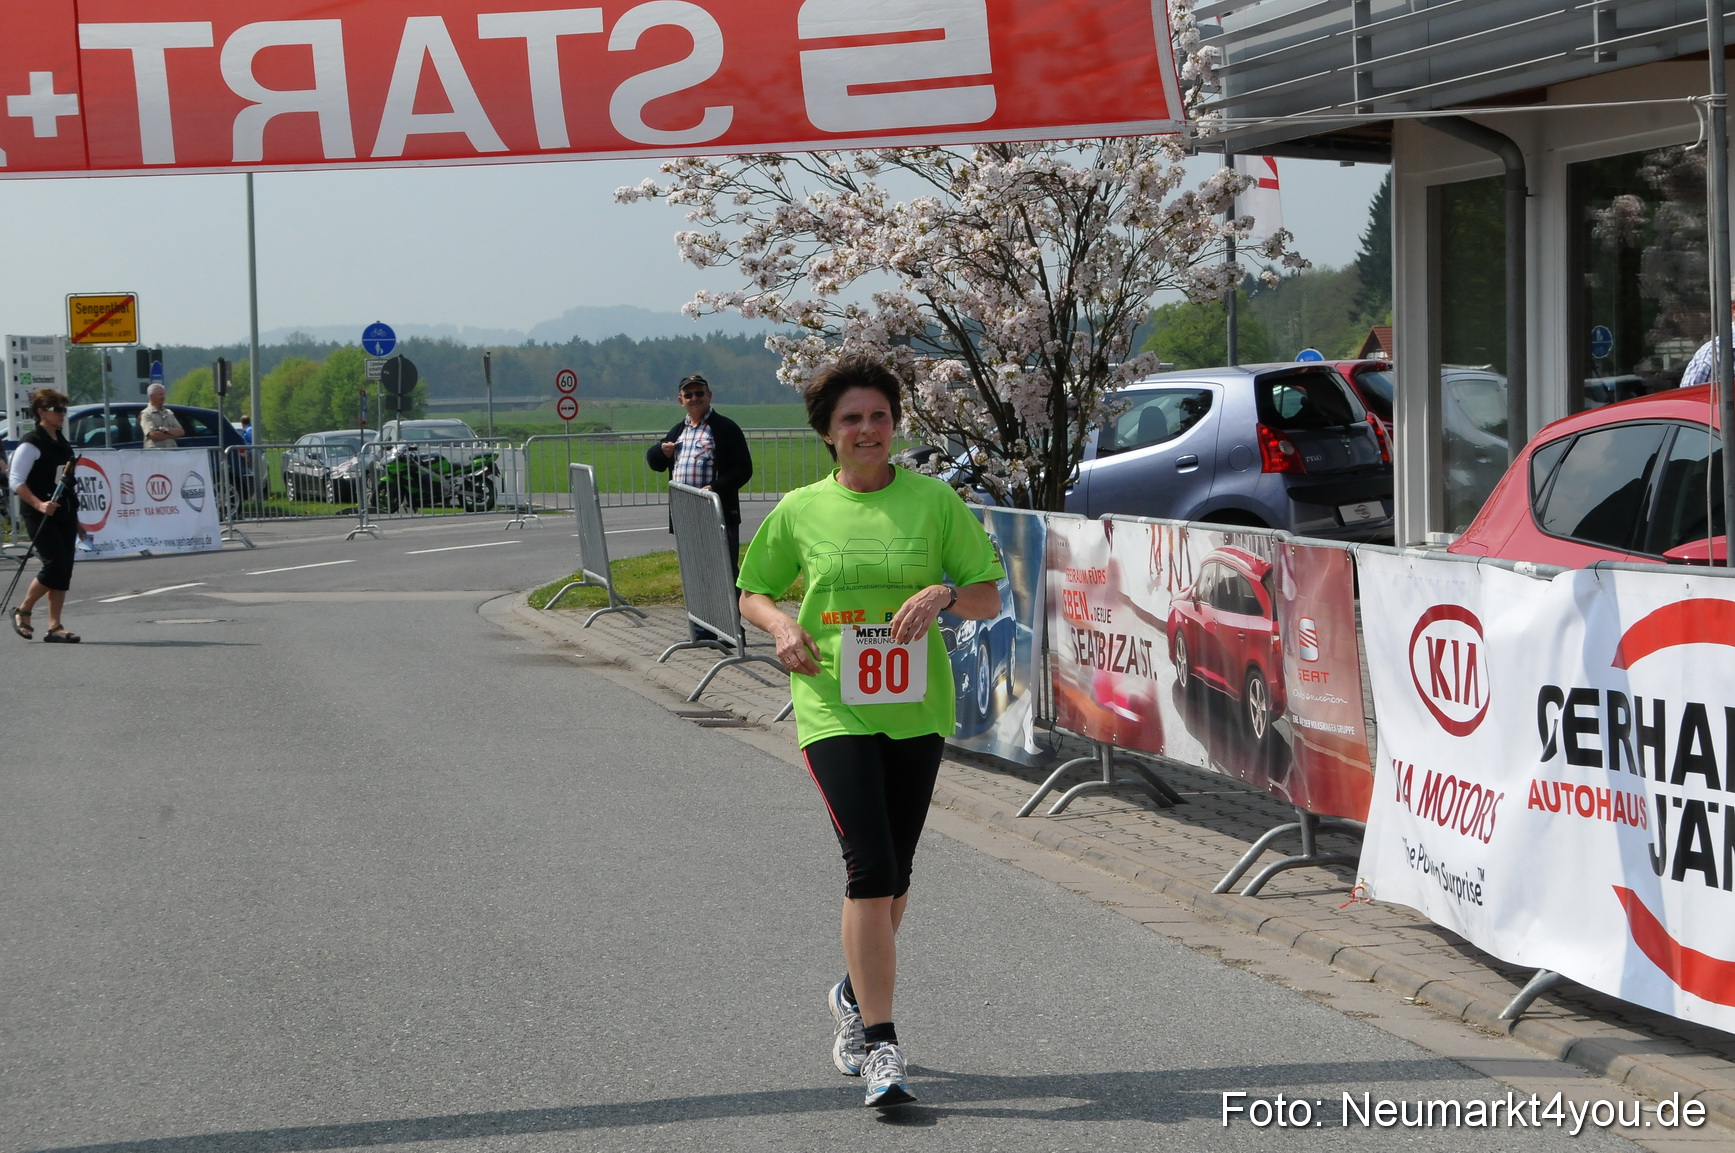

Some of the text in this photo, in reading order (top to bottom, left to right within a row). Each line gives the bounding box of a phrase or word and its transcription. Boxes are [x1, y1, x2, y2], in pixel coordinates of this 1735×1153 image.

[75, 302, 129, 317] Sengenthal
[560, 376, 573, 388] 60
[77, 477, 97, 493] ART
[150, 481, 168, 495] KIA
[183, 487, 205, 495] NISSA
[117, 509, 141, 517] SEAT
[155, 506, 180, 515] MOTORS
[1088, 566, 1107, 585] FÜRS
[821, 609, 866, 625] MERZ
[858, 647, 910, 695] 80
[1425, 636, 1479, 709] KIA
[1337, 724, 1355, 735] GRUPPE
[1416, 769, 1505, 845] MOTORS
[1528, 779, 1647, 830] AUTOHAUS
[1441, 862, 1483, 906] Surprise
